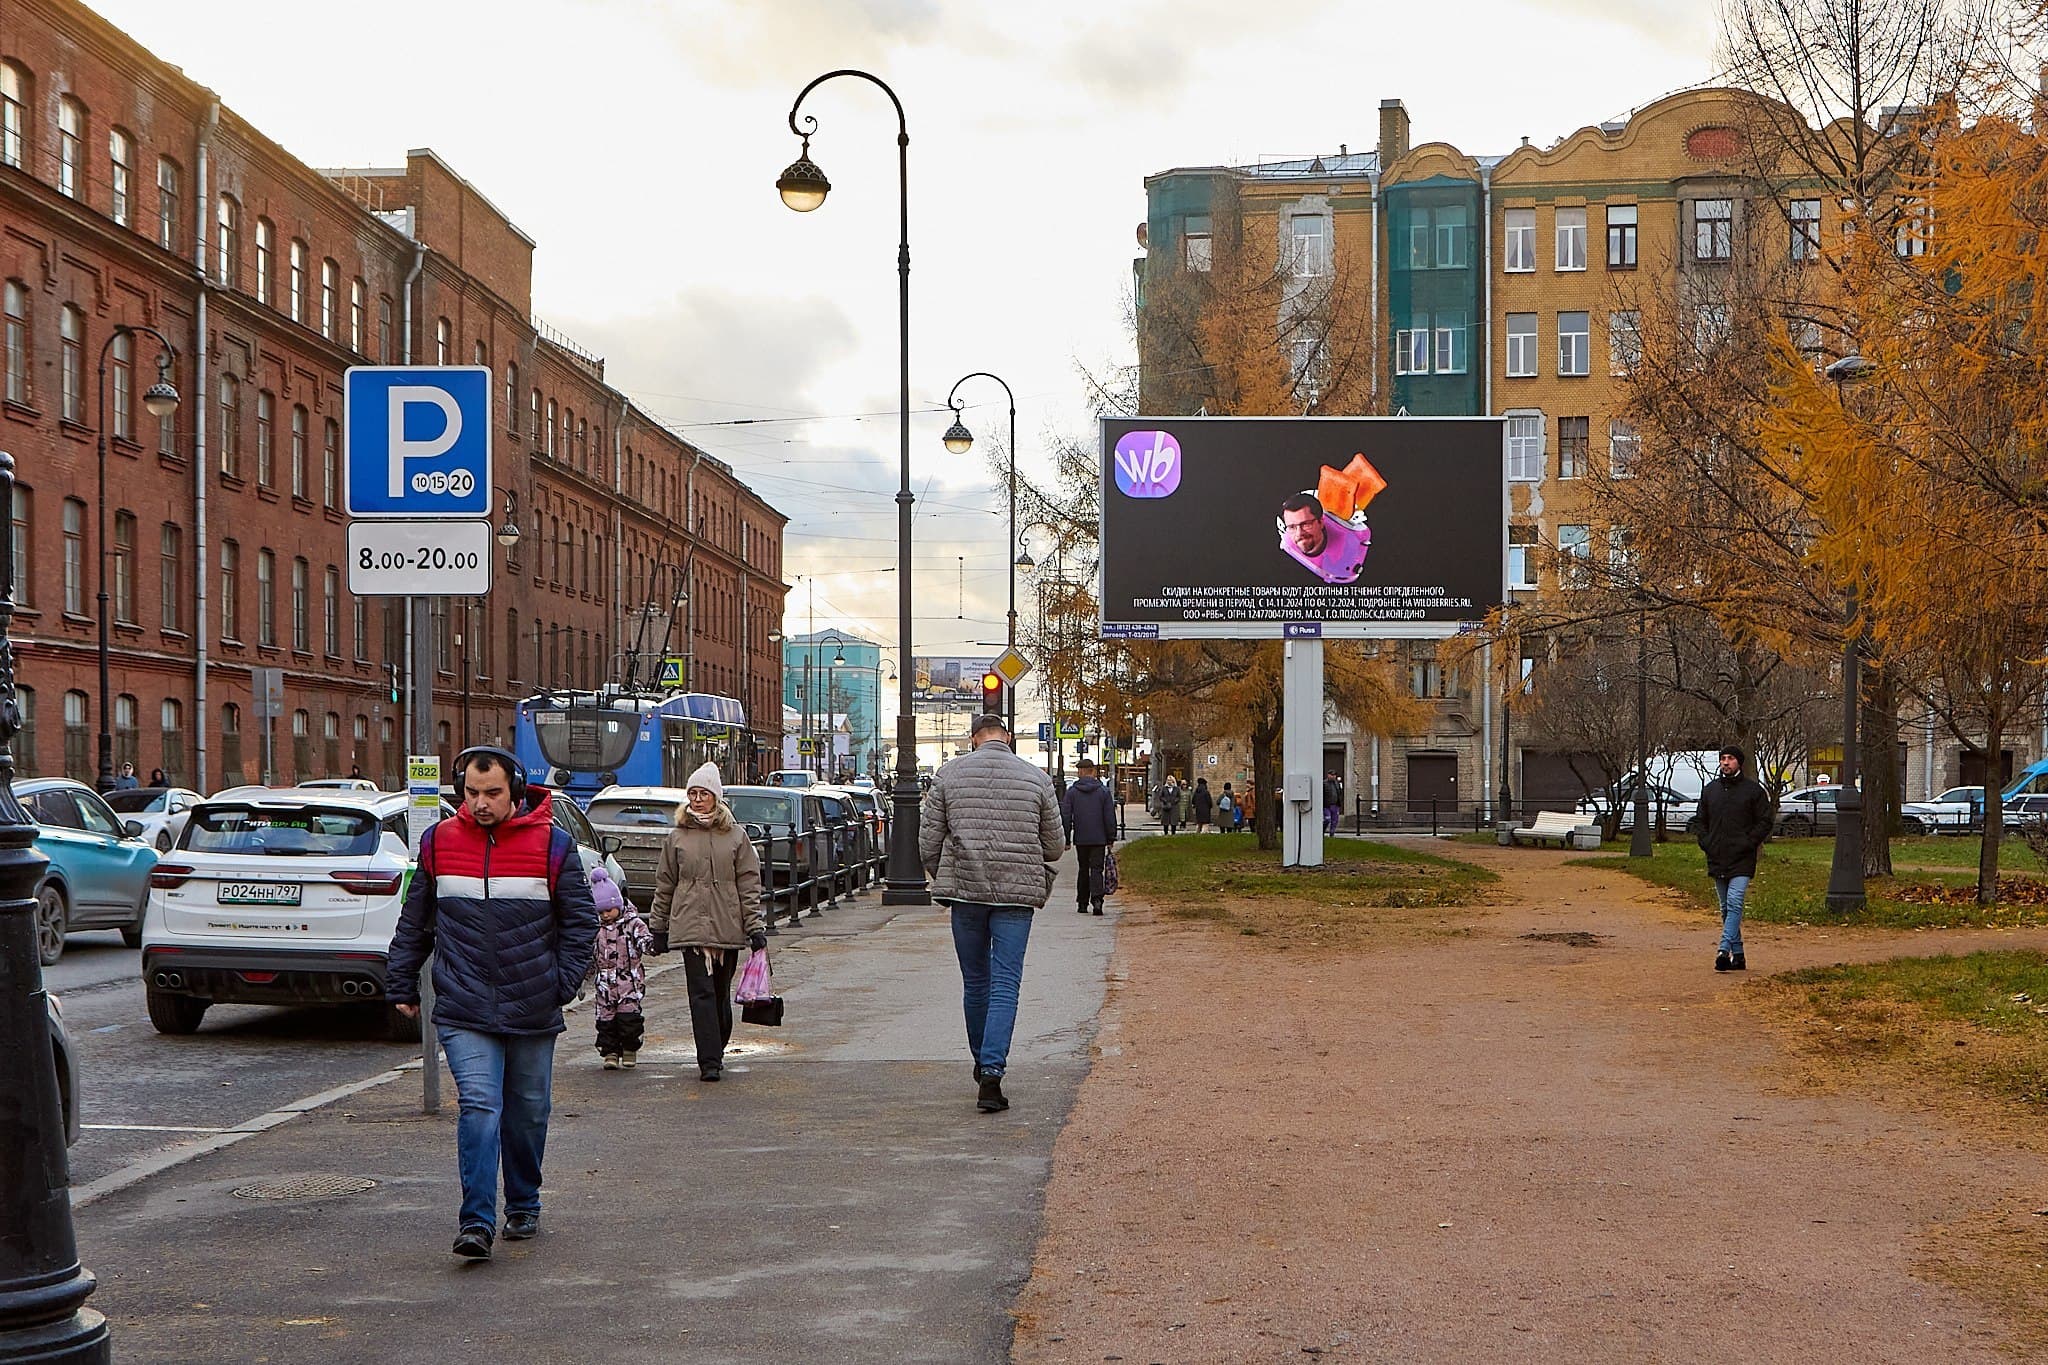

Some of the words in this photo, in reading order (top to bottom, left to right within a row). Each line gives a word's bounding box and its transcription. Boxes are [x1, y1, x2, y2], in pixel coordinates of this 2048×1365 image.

[388, 386, 463, 498] P
[416, 477, 428, 488] 10
[431, 476, 446, 489] 15
[450, 475, 473, 491] 20
[359, 547, 478, 570] 8.00-20.00
[1162, 586, 1191, 597] СКИДКИ
[1193, 586, 1203, 597] НА
[1204, 586, 1250, 597] КОНКРЕТНЫЕ
[1252, 586, 1281, 597] ТОВАРЫ
[1282, 586, 1302, 597] БУДУТ
[1303, 586, 1343, 597] ДОСТУПНЫ
[1344, 586, 1350, 597] В
[1350, 586, 1382, 597] ТЕЧЕНИЕ
[1383, 586, 1445, 597] ОПРЕДЕЛЕННОГО
[1133, 598, 1182, 608] ПРОМЕЖУТКА
[1182, 598, 1218, 608] ВРЕМЕНИ
[1219, 598, 1225, 608] В
[1225, 598, 1255, 608] ПЕРИОД
[1266, 598, 1303, 608] 14.11.2024
[1304, 598, 1316, 608] ПО
[1358, 598, 1401, 608] ПОДРОБНЕЕ
[1402, 598, 1413, 608] НА
[1299, 626, 1316, 634] Russ
[607, 720, 618, 733] 10
[411, 767, 437, 777] 7822
[529, 768, 545, 776] 3631
[277, 885, 298, 897] 797
